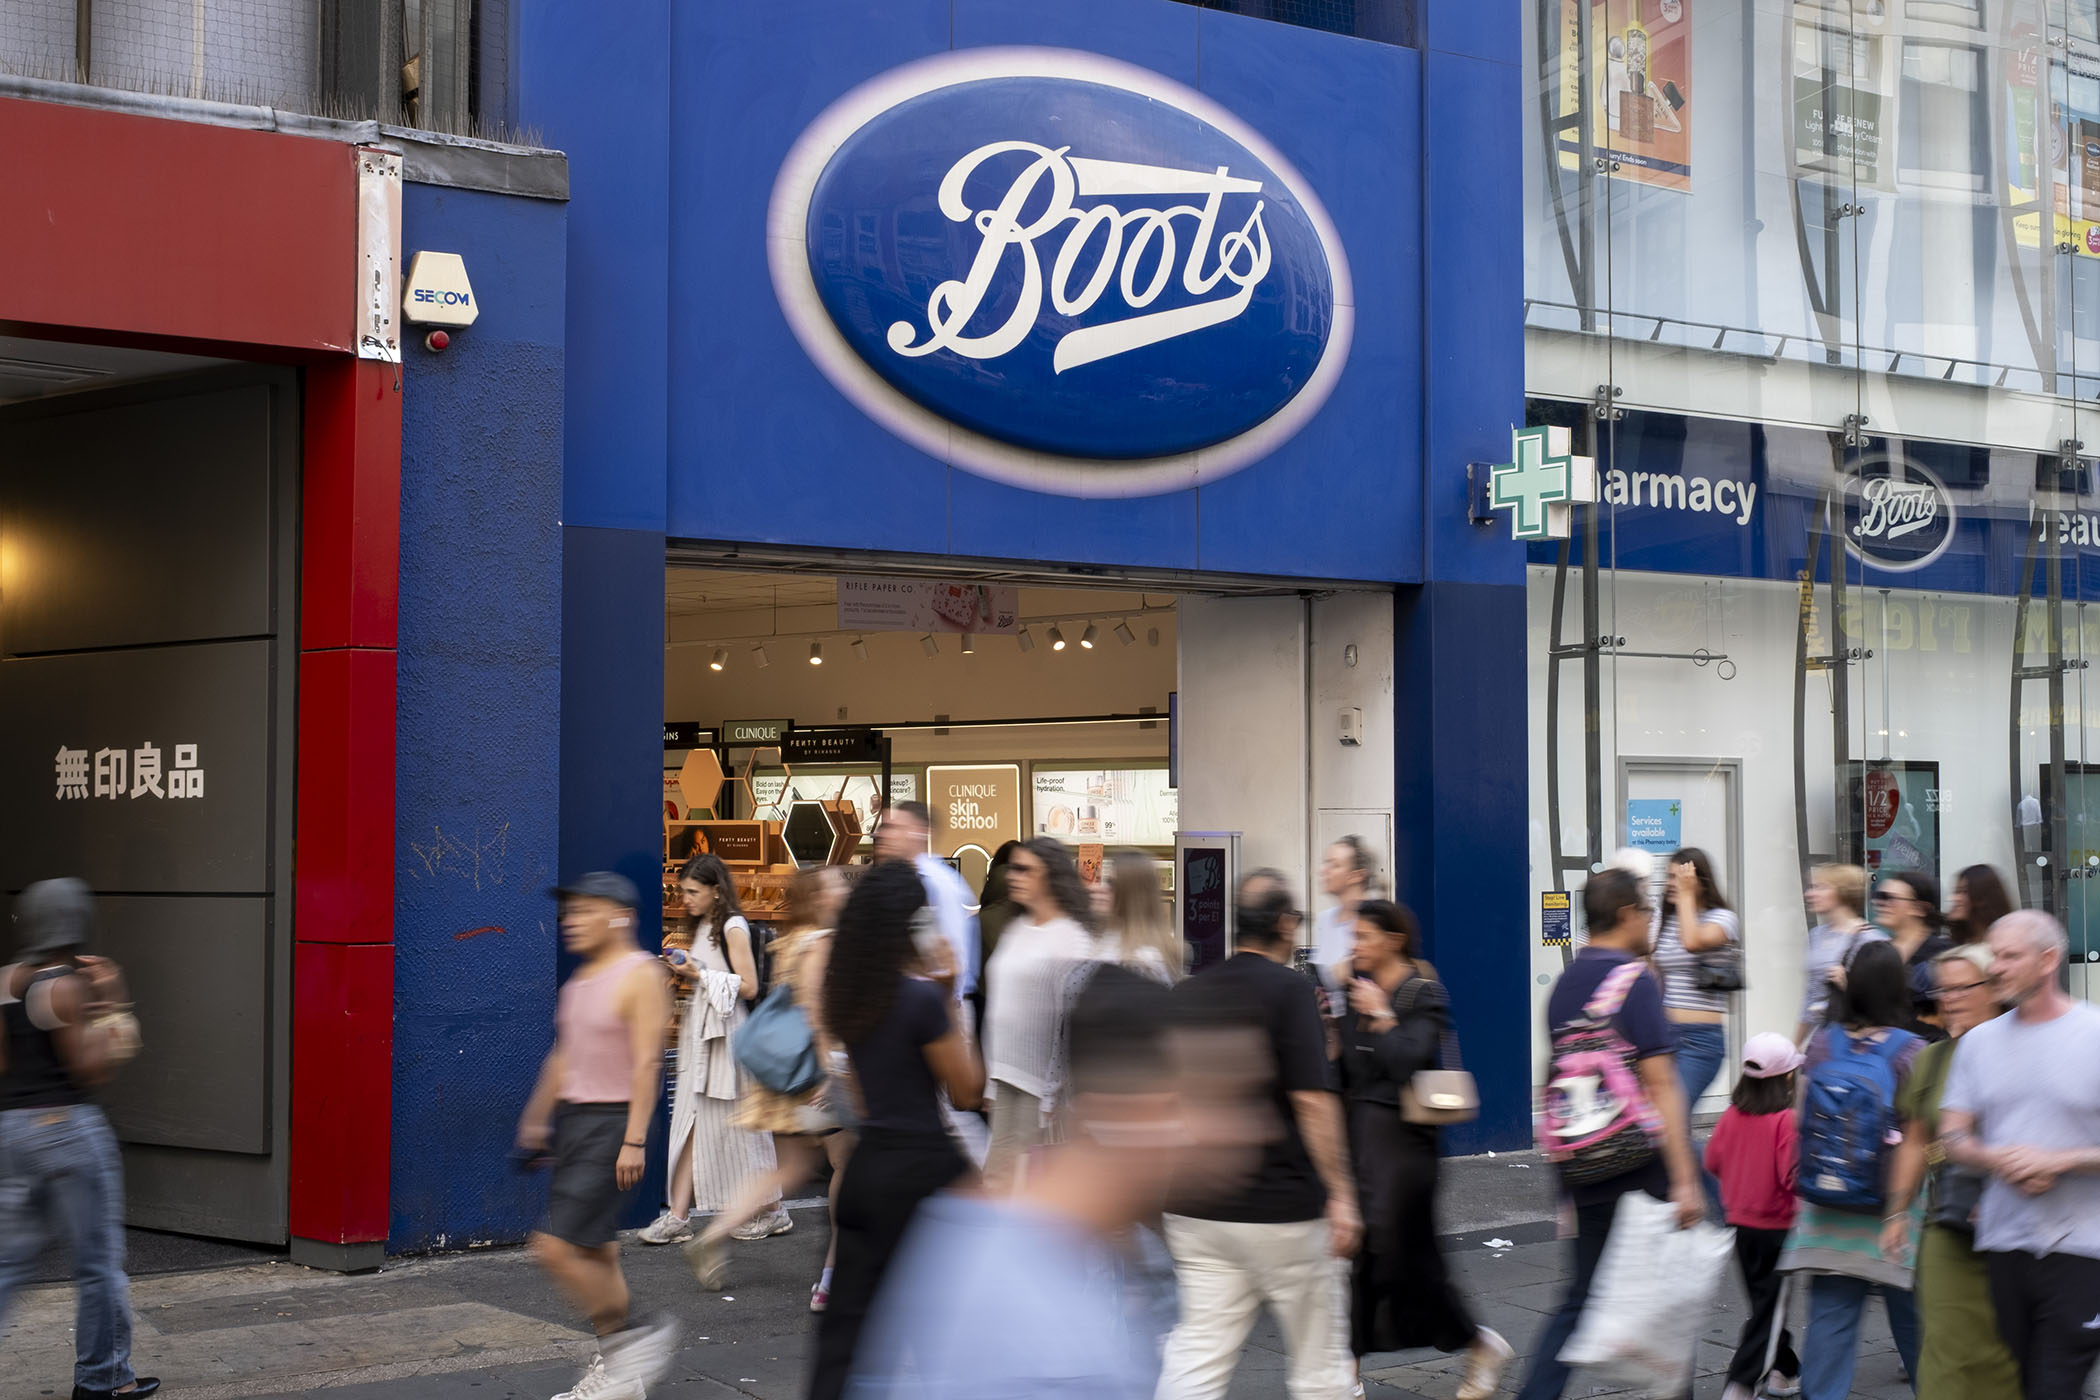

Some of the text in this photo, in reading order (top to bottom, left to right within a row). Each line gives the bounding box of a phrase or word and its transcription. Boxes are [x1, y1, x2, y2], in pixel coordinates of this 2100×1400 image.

[887, 140, 1272, 376] Boots
[414, 288, 470, 306] SECOM
[1853, 477, 1938, 541] Boots
[846, 582, 868, 592] RIFLE
[872, 583, 897, 593] PAPER
[735, 726, 777, 741] CLINIQUE
[822, 737, 855, 746] BEAUTY
[55, 741, 204, 800] 無印良品
[1036, 777, 1065, 786] Life-proof
[948, 784, 997, 799] CLINIQUE
[1867, 790, 1889, 807] 1/2
[949, 798, 979, 816] skin
[949, 812, 998, 829] school
[1631, 815, 1663, 826] Services
[1631, 827, 1666, 837] available
[1188, 898, 1198, 921] 3
